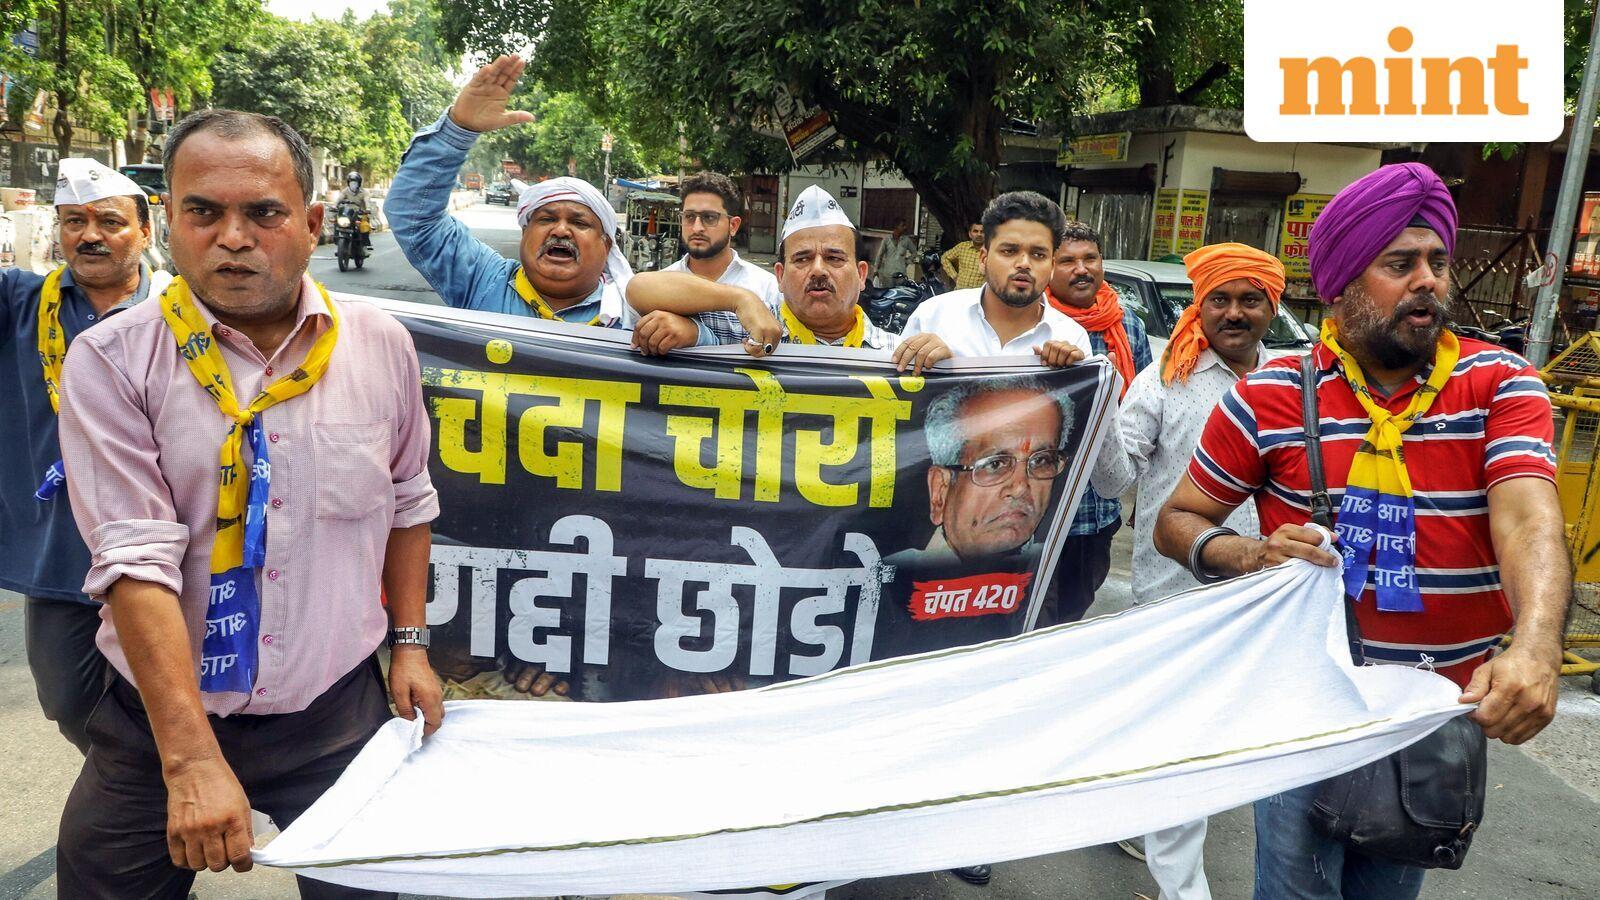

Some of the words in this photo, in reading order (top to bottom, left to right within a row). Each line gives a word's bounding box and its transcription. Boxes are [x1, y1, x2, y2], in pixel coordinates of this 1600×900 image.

[1286, 221, 1315, 240] पा
[1284, 241, 1310, 259] फो
[422, 339, 641, 492] चंदा
[659, 367, 925, 508] चोरों
[427, 515, 627, 673] गद्दी
[924, 585, 973, 614] चंपत
[972, 584, 1018, 609] 420
